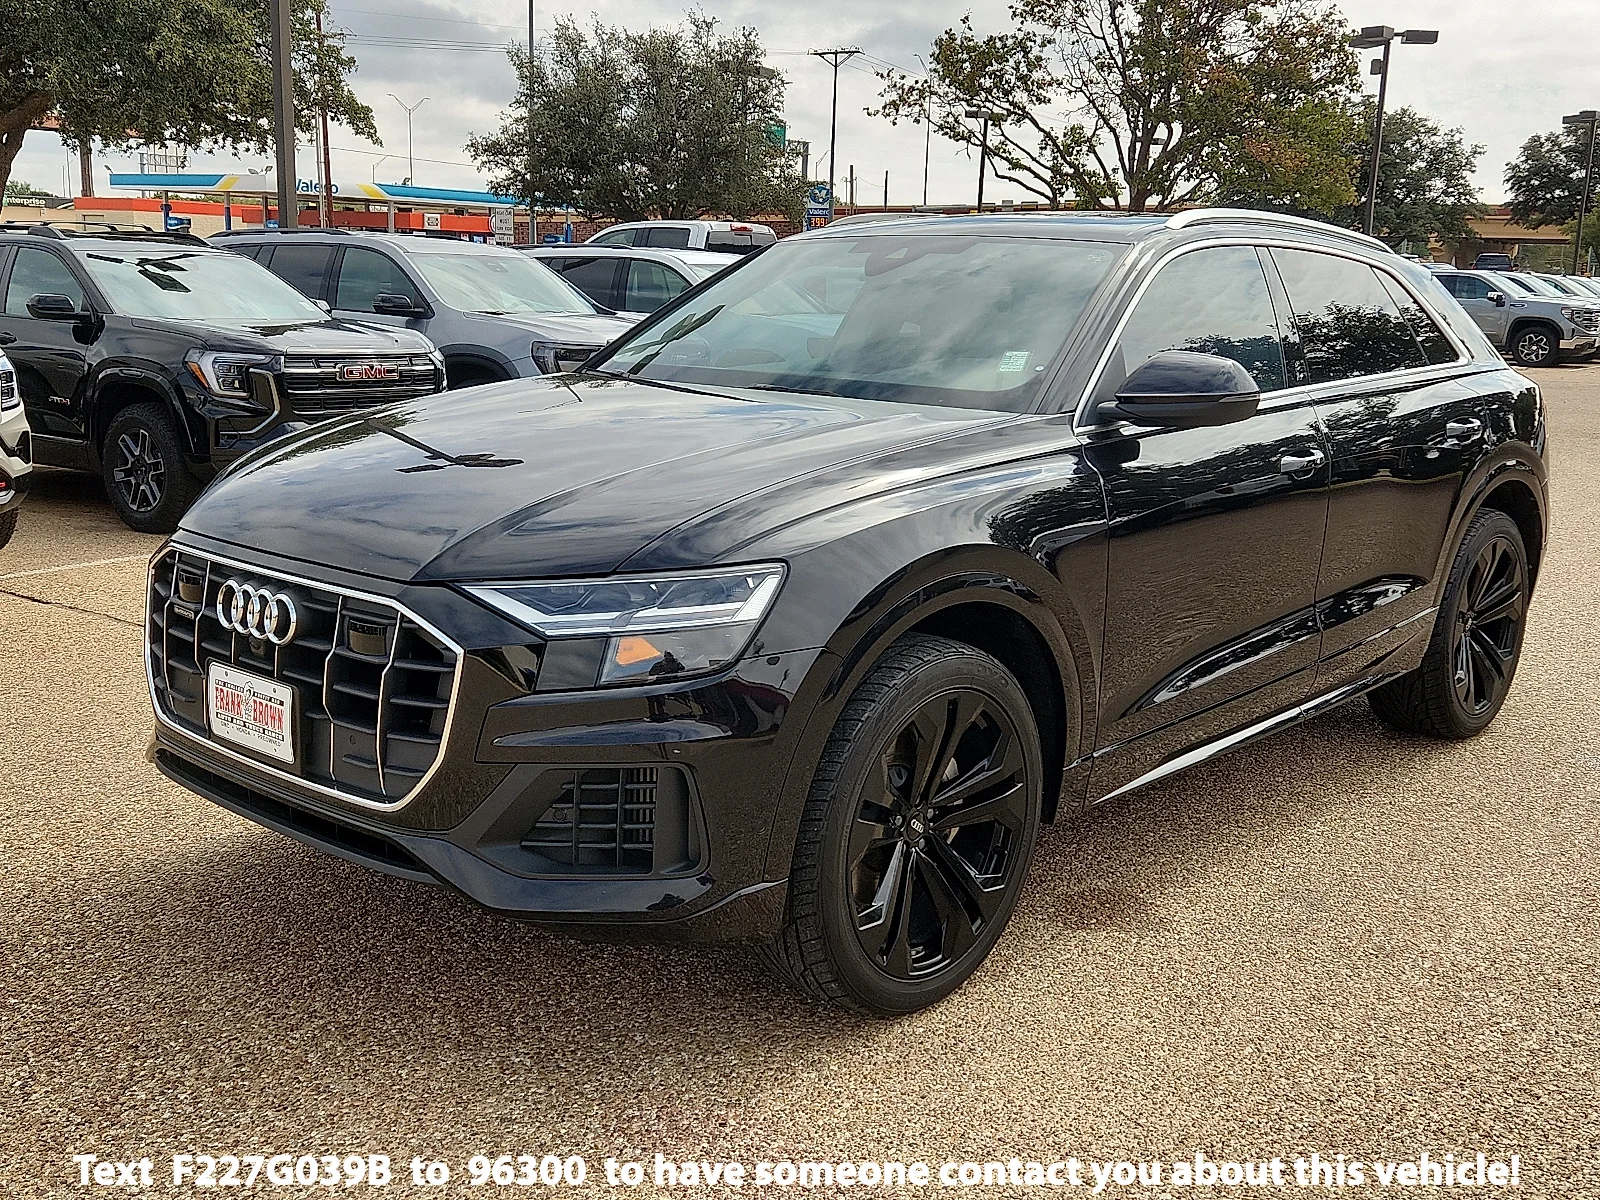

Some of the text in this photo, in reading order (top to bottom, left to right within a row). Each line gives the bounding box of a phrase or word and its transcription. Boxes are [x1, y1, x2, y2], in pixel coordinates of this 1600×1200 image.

[6, 197, 46, 206] nterprise
[344, 365, 399, 379] GMC
[214, 686, 244, 719] FRANK
[252, 699, 285, 734] BROWN
